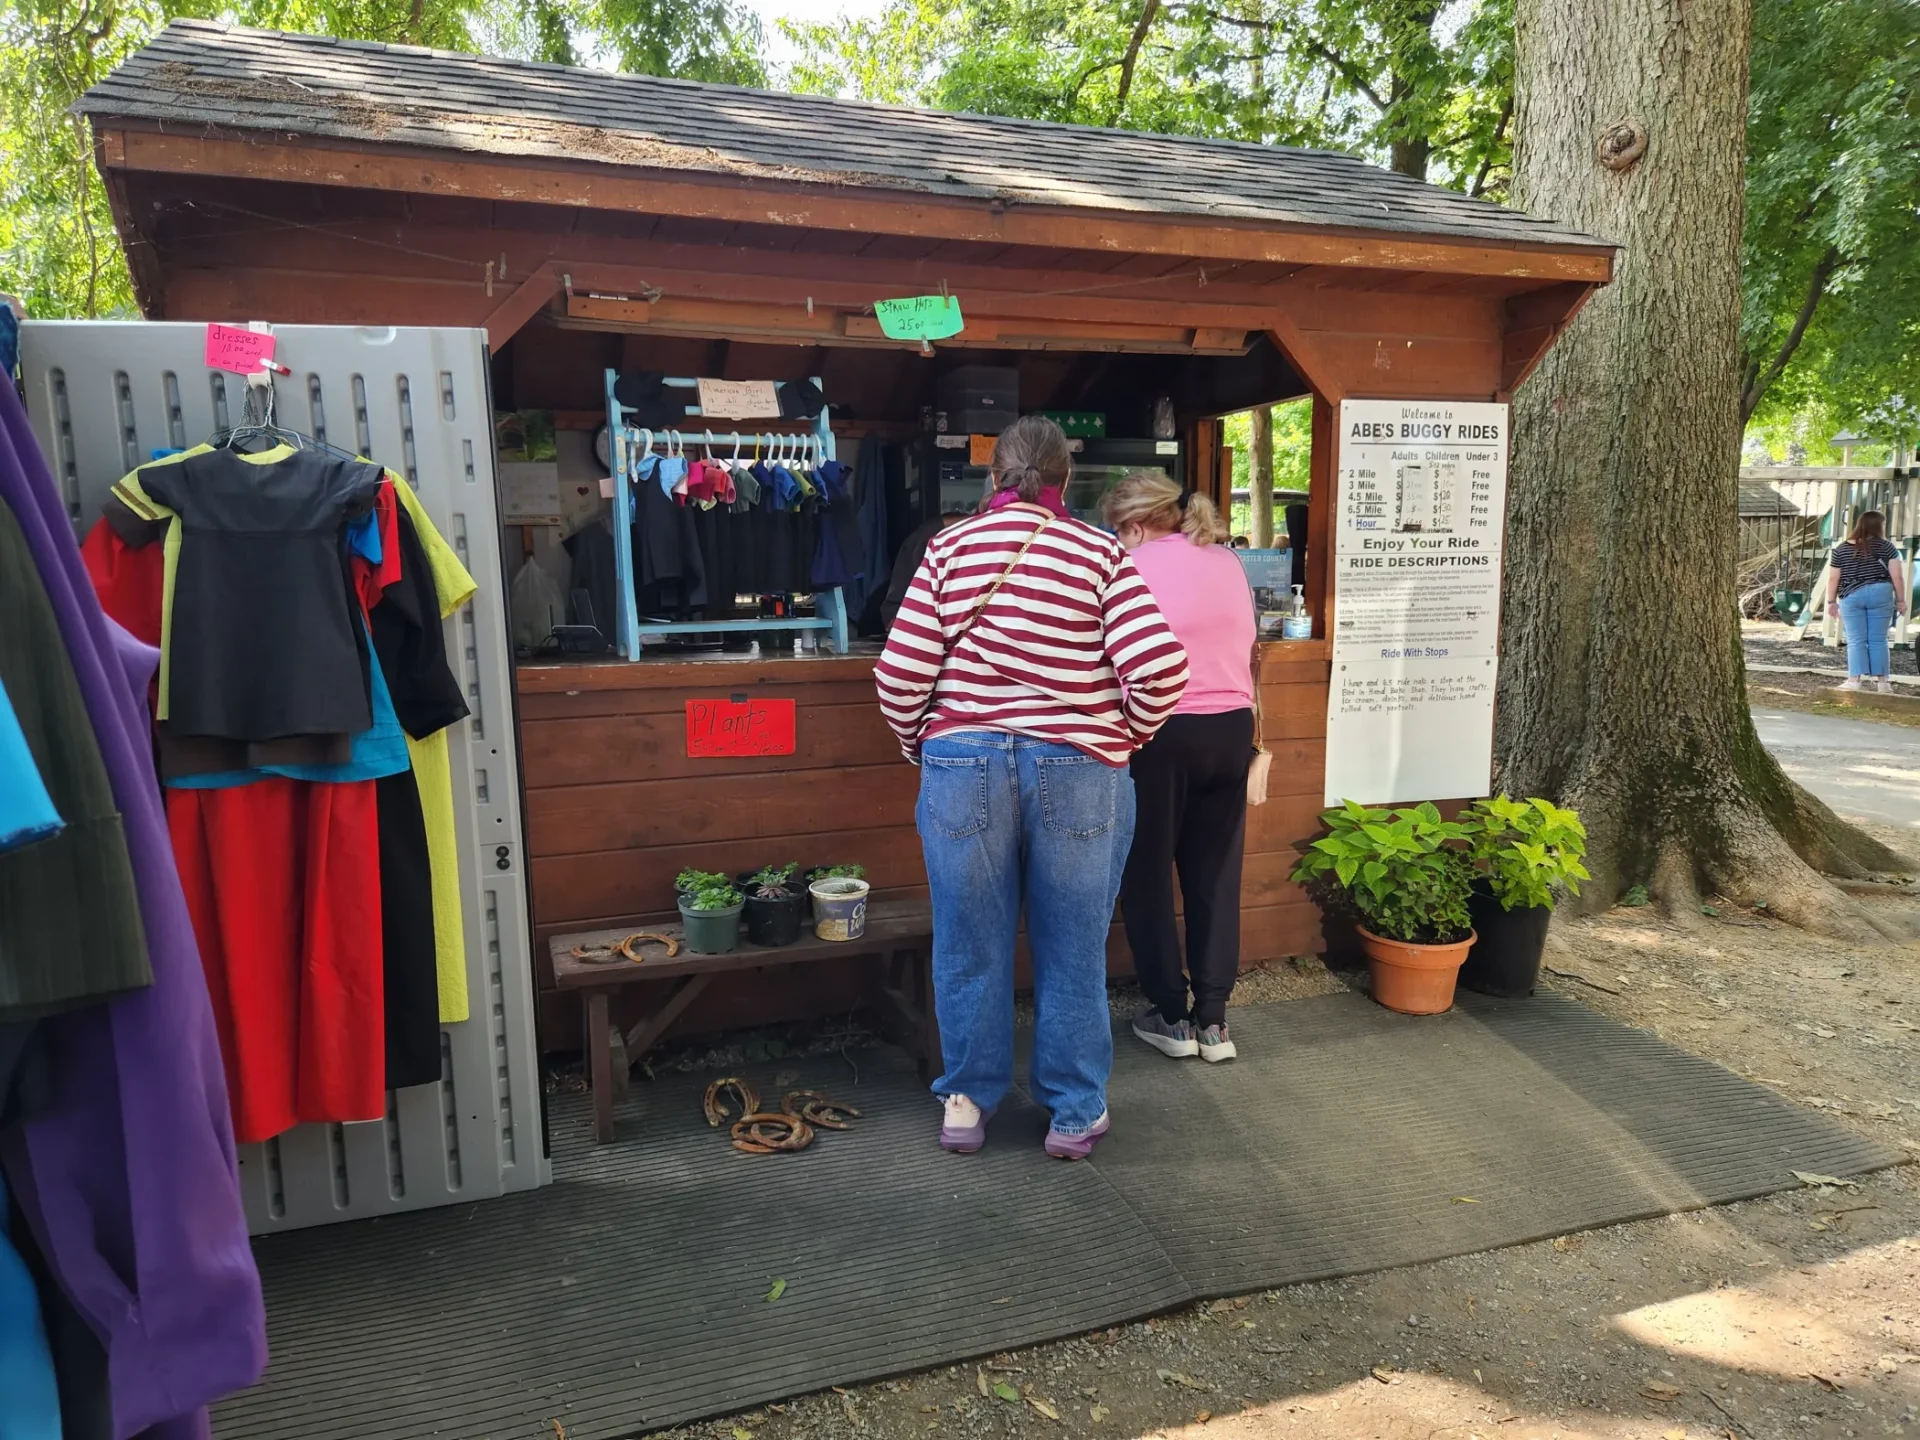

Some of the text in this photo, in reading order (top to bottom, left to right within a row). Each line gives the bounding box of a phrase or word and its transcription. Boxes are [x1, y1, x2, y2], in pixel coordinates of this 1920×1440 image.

[212, 325, 259, 344] dresses
[1401, 407, 1453, 420] Welcome to
[1351, 422, 1499, 440] ABE'S BUGGY RIDES
[1391, 451, 1498, 461] Adults Children Under 3
[1349, 469, 1355, 478] 2
[1358, 469, 1376, 478] Mile
[1472, 469, 1490, 479] Free
[1348, 480, 1354, 490] 3
[1357, 480, 1376, 490] Mile
[1471, 481, 1490, 490] Free
[1347, 492, 1362, 501] 4.5
[1364, 492, 1383, 501] Mile
[1471, 492, 1489, 501] Free
[1347, 504, 1361, 514] 6.5
[1364, 504, 1382, 514] Mile
[1470, 504, 1488, 514] Free
[1356, 518, 1377, 528] Hour
[1469, 518, 1488, 527] Free
[1363, 537, 1480, 551] Enjoy Your Ride
[1263, 554, 1287, 562] COUNTY
[1350, 556, 1489, 568] RIDE DESCRIPTIONS
[1381, 647, 1449, 659] Ride With Stops
[1397, 677, 1410, 686] ride
[1431, 685, 1446, 694] They
[692, 702, 768, 735] Plants
